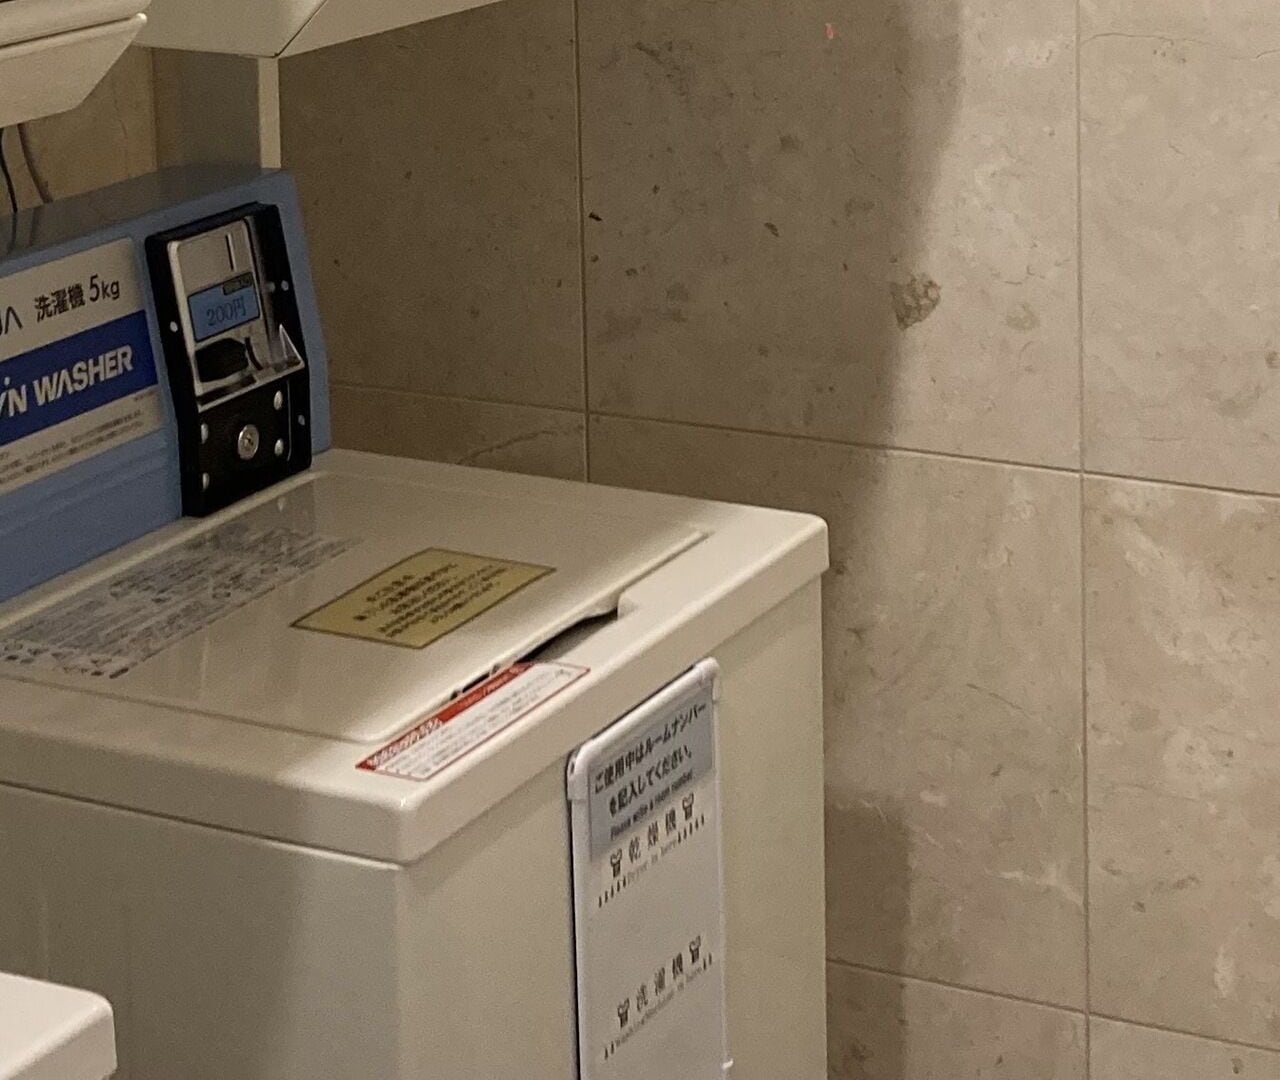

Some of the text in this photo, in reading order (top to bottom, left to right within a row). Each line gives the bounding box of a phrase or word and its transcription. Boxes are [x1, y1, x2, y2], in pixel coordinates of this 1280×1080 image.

[34, 282, 86, 322] 洗濯機
[32, 344, 134, 407] WASHER
